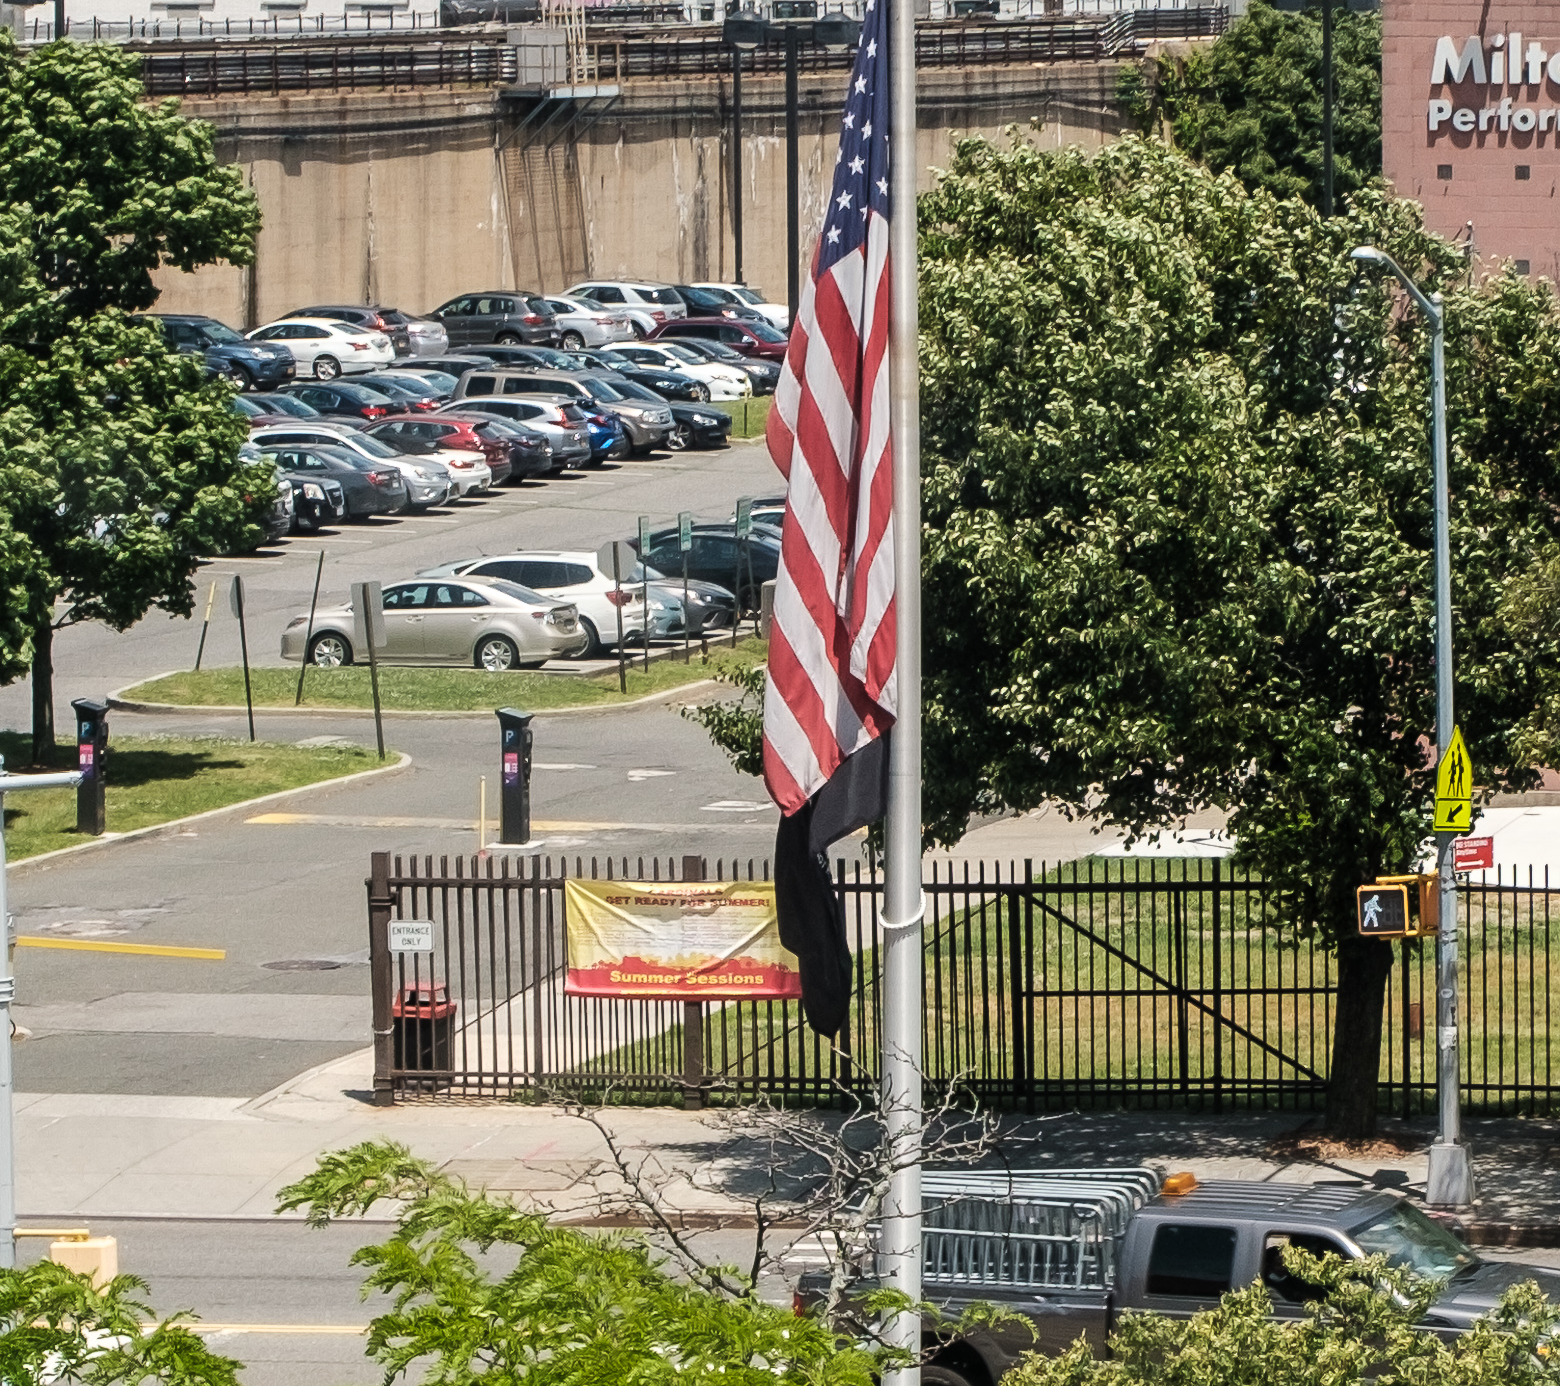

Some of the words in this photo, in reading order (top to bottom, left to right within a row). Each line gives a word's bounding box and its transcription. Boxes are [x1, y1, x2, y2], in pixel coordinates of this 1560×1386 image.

[505, 730, 514, 743] P
[606, 896, 630, 906] GET
[635, 897, 677, 907] READY
[710, 898, 770, 907] SUMMER!
[392, 926, 430, 936] ENTRANCE
[401, 937, 421, 946] ONLY
[610, 970, 682, 984] Summer
[686, 971, 764, 985] Sessions
